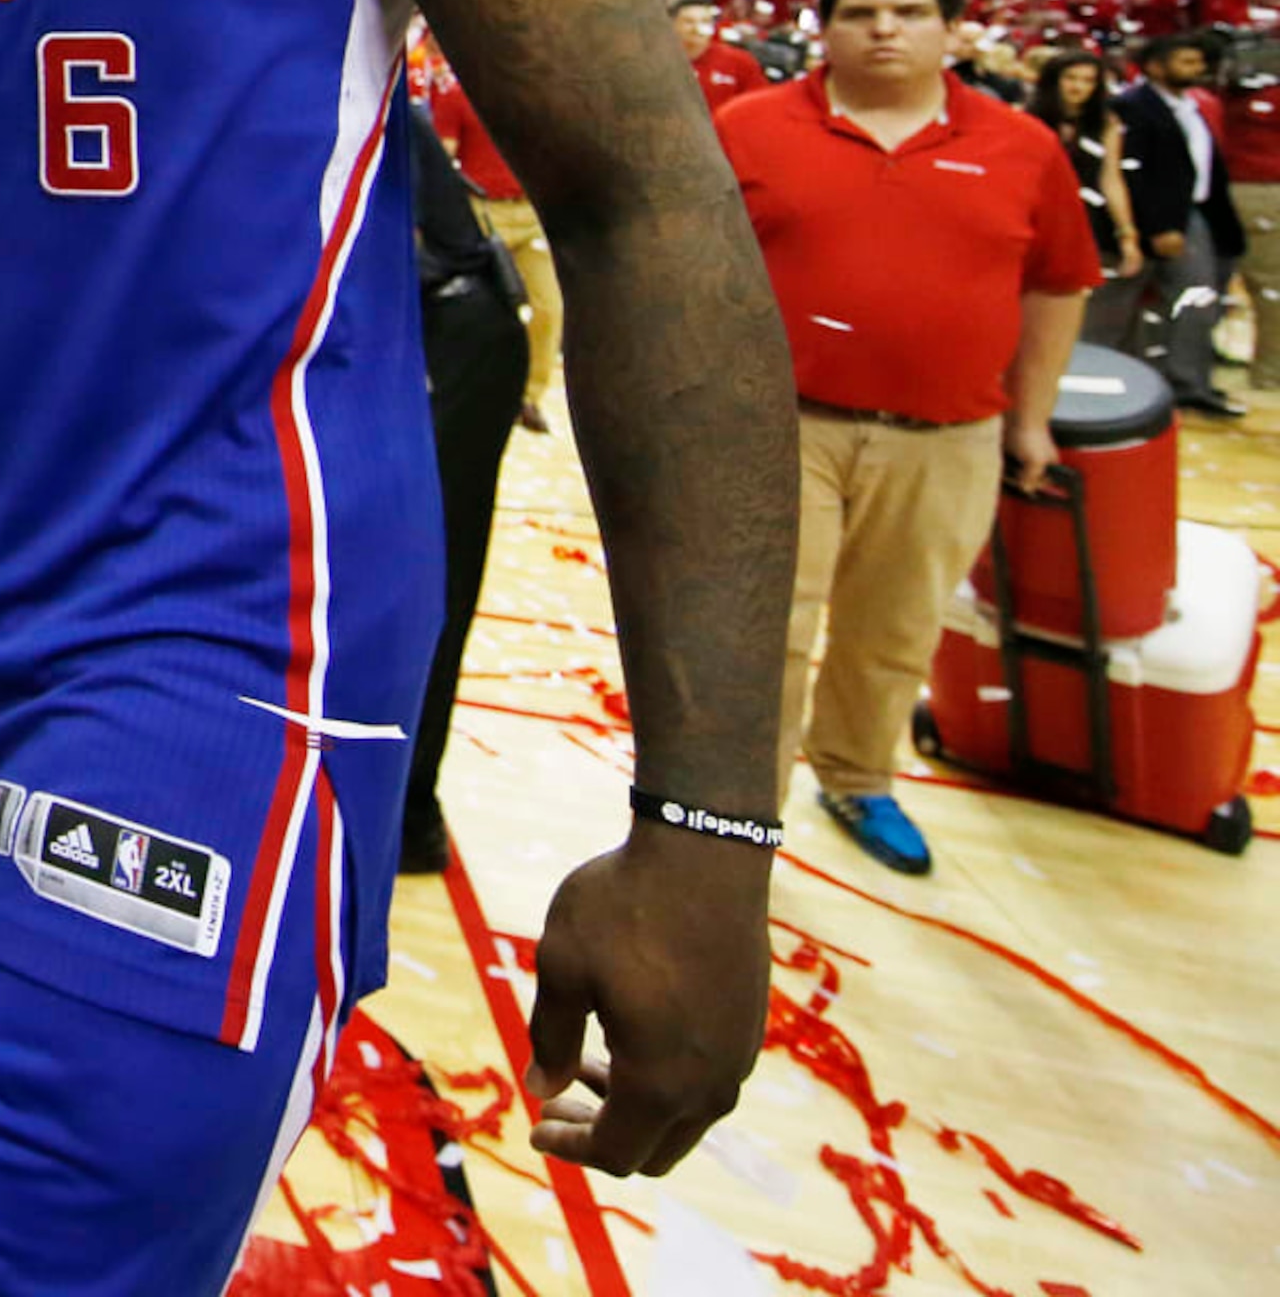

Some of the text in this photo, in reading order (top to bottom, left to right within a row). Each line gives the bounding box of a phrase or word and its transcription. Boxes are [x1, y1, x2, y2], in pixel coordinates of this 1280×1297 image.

[37, 30, 139, 197] 6
[49, 841, 100, 870] adidas
[154, 865, 198, 899] 2XL
